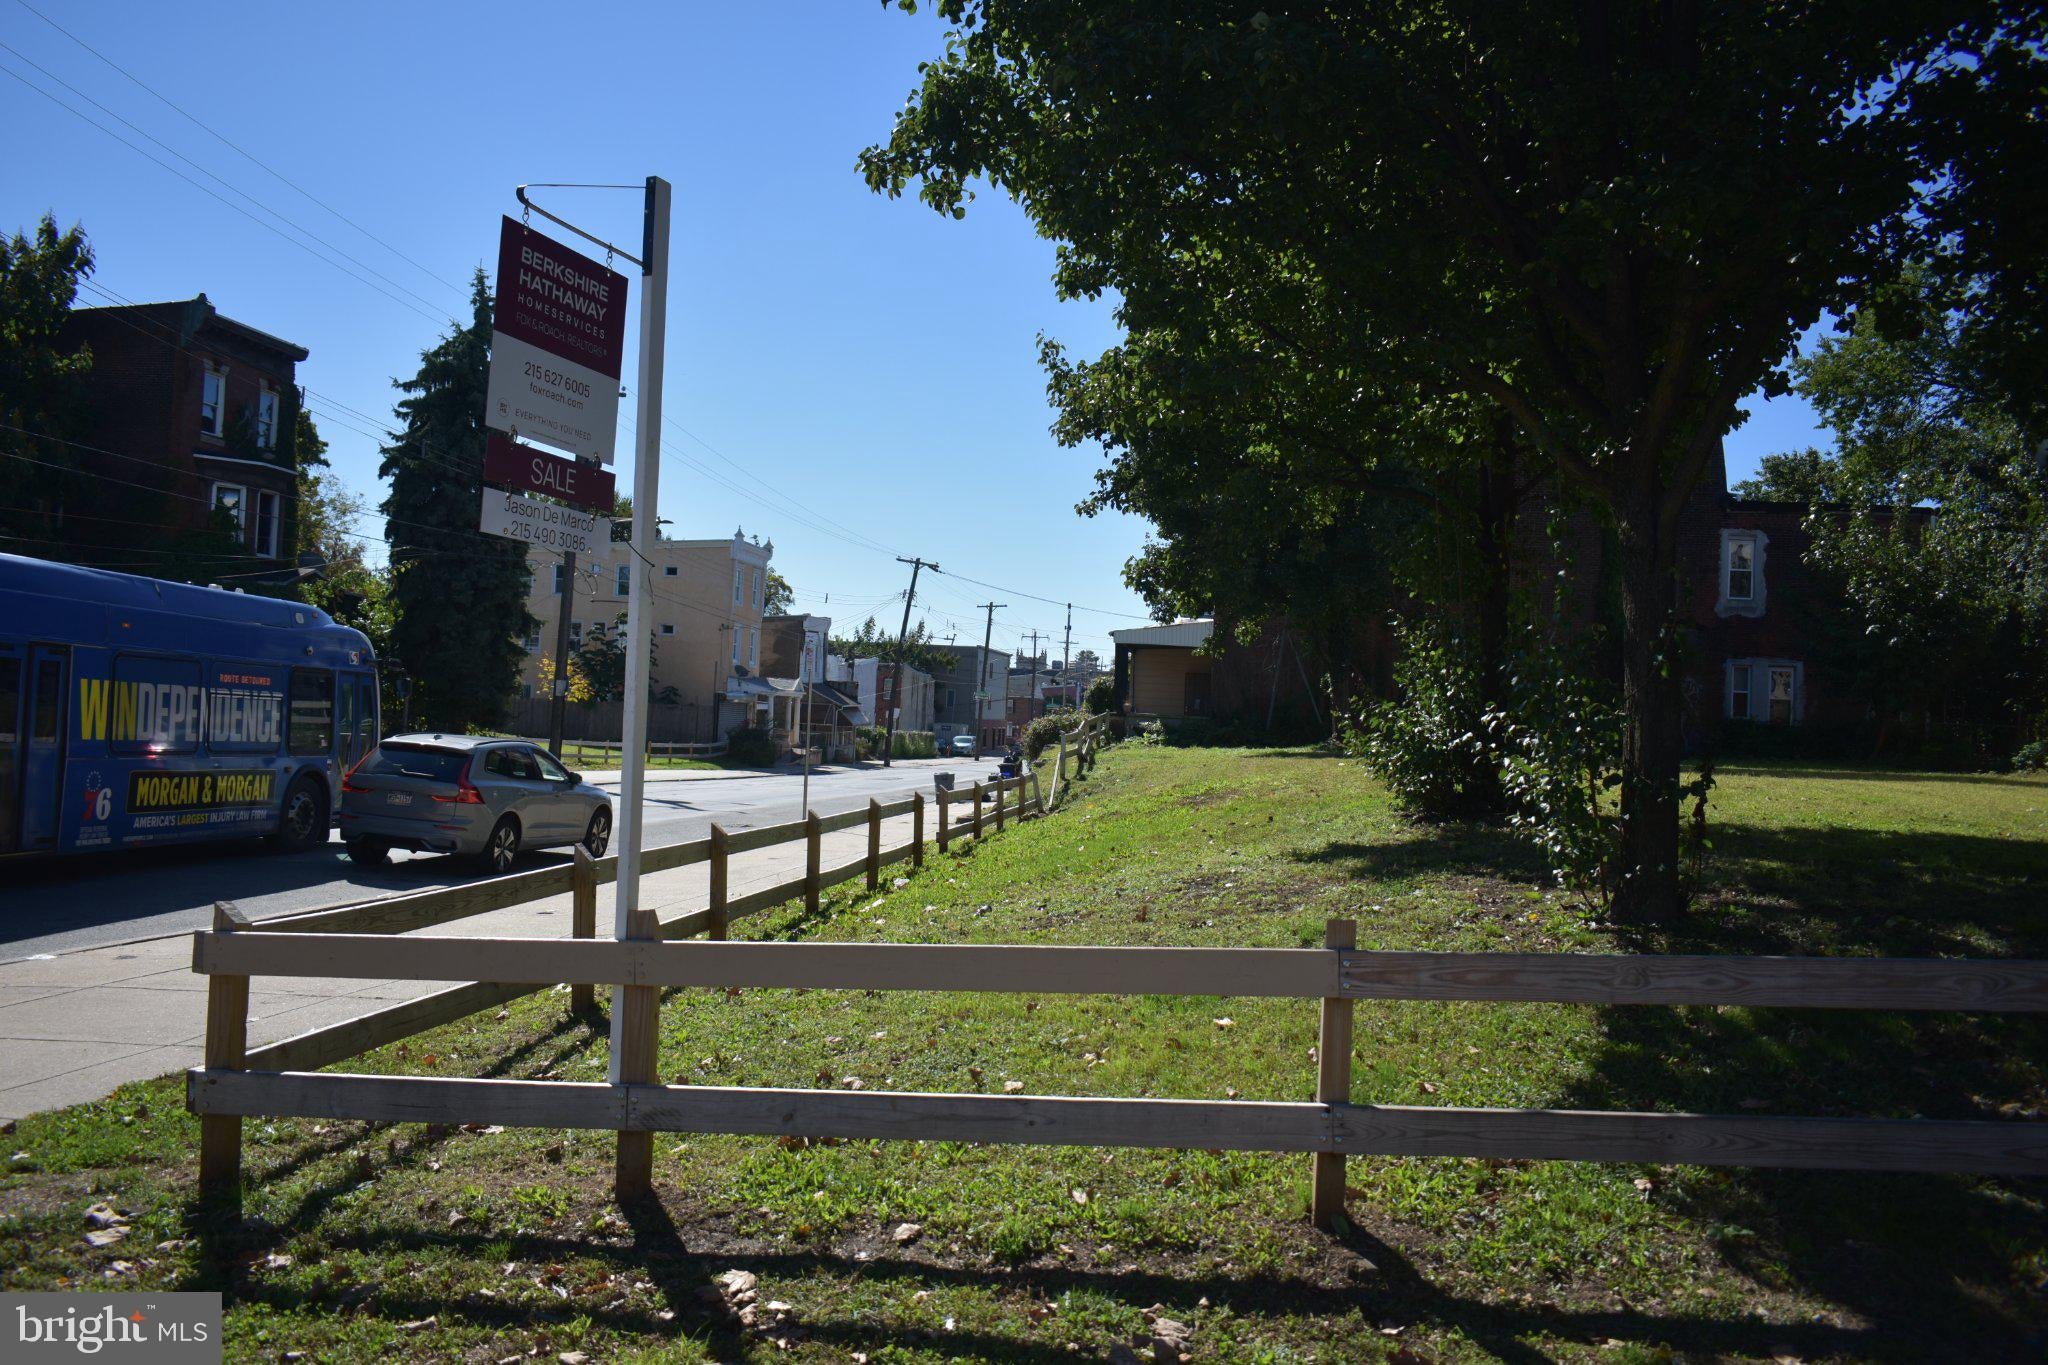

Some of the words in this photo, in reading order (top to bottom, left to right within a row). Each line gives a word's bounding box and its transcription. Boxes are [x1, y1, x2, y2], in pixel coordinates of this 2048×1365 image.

[521, 246, 609, 302] BERKSHIRE
[519, 269, 607, 322] HATHAWAY
[517, 293, 606, 340] HOMESERVICES
[524, 361, 542, 381] 215
[544, 369, 563, 387] 627
[565, 377, 591, 398] 6005
[529, 382, 584, 410] foxroach.com
[515, 408, 558, 430] EVERYTHING
[560, 424, 574, 435] YOU
[575, 430, 592, 441] NEED
[531, 458, 577, 495] SALE
[504, 499, 541, 520] Jason
[543, 507, 559, 524] De
[561, 513, 594, 533] Marco
[511, 521, 531, 538] 215
[533, 528, 557, 545] 490
[558, 533, 586, 552] 3086
[80, 678, 283, 743] WINDEPENDENCE
[82, 788, 112, 822] 76
[136, 776, 198, 807] MORGAN
[201, 777, 212, 802] &
[216, 774, 270, 802] MORGAN
[133, 816, 176, 829] AMERICA'S
[177, 813, 209, 825] LARGEST
[210, 811, 235, 823] INJURY
[236, 810, 250, 821] LAW
[252, 809, 267, 820] FIRM
